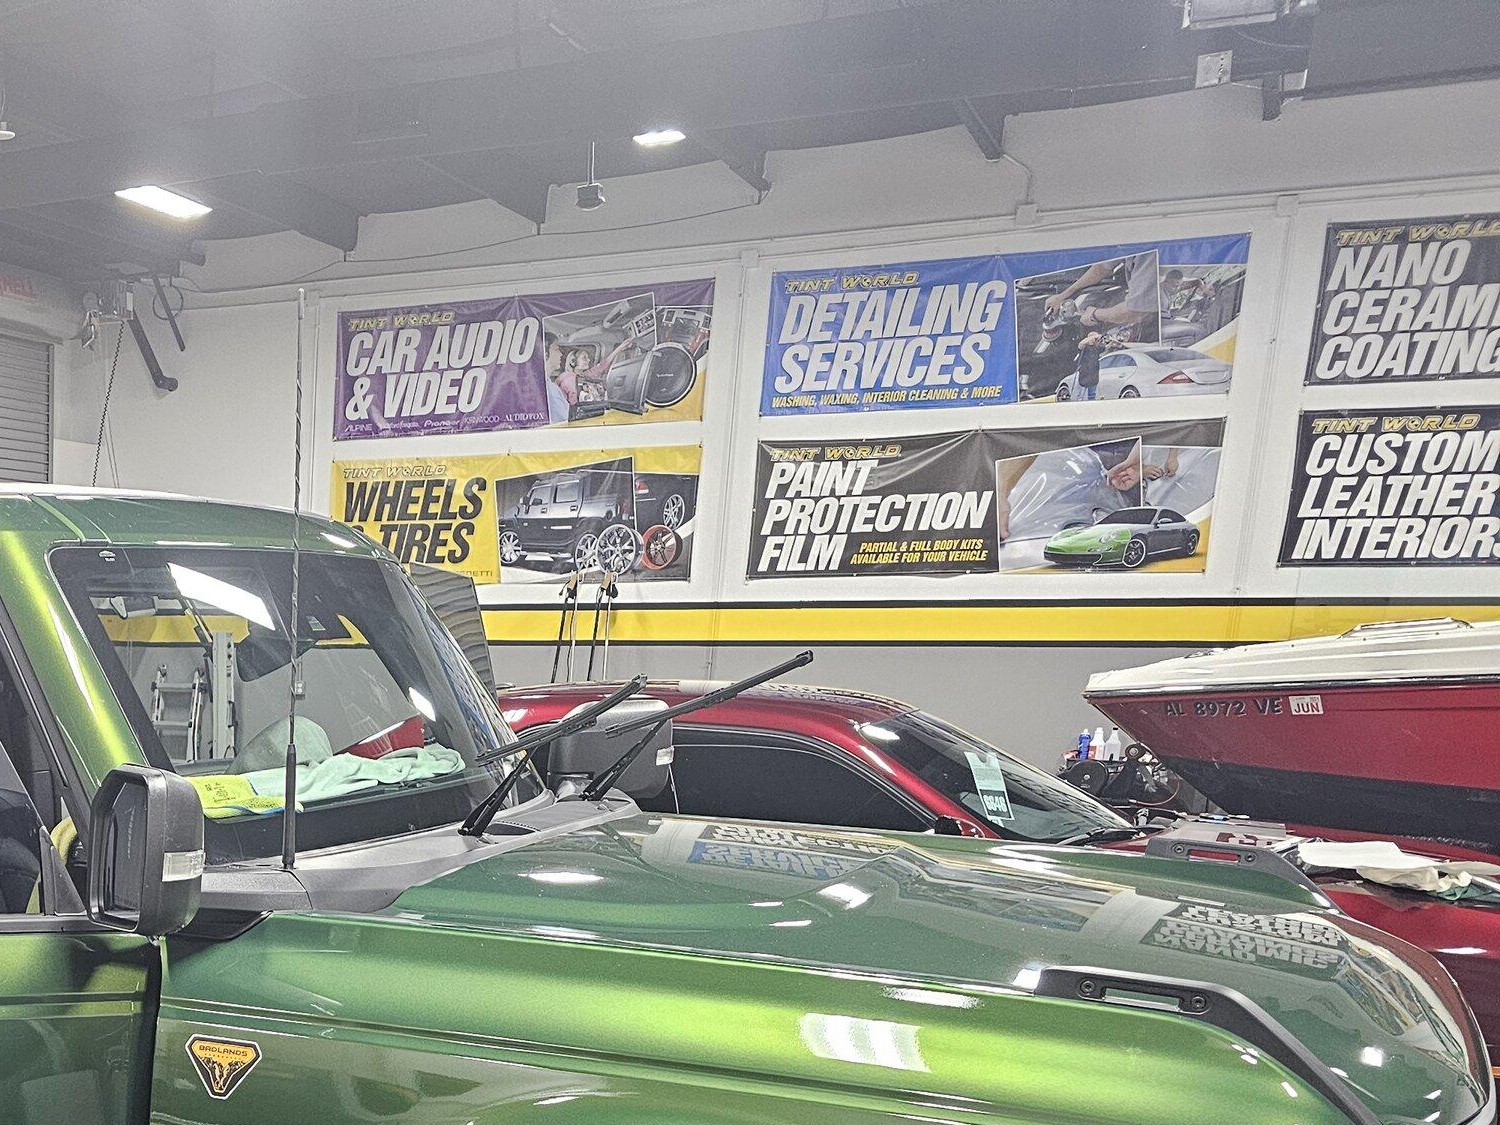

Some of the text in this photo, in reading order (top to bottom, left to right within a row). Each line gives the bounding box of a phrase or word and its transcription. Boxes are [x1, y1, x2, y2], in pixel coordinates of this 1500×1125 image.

[1337, 226, 1404, 246] TINT
[785, 271, 919, 293] TINT WORLD
[1325, 239, 1472, 291] NANO
[348, 311, 456, 331] TINT WORLD
[778, 280, 1008, 344] DETAILING
[1322, 283, 1500, 336] CERAM
[346, 316, 540, 377] CAR AUDIO
[774, 333, 992, 394] SERVICES
[345, 366, 487, 421] & VIDEO
[771, 386, 1003, 408] WASHING, WAXING, INTERIOR CLEANING & MORE
[345, 423, 373, 432] ALPINE
[1312, 413, 1481, 434] TINT WORLD
[343, 465, 447, 478] TINT WORLD
[770, 444, 901, 461] TINT WORLD
[1305, 429, 1500, 476] CUSTOM
[764, 459, 879, 498] PAINT
[1297, 473, 1500, 518] LEATHER
[344, 476, 487, 522] WHEELS
[760, 490, 994, 535] PROTECTION
[379, 521, 475, 564] TIRES
[757, 534, 848, 572] FILM
[859, 539, 984, 554] PARTIAL & FULL BODY KITS
[1290, 516, 1500, 559] INTERIOR
[850, 550, 988, 565] AVAILABLE FOR YOUR VEHICLE
[1165, 697, 1283, 717] AL 8972 VE
[1293, 702, 1321, 713] JUN
[199, 1044, 248, 1057] BADLANDS
